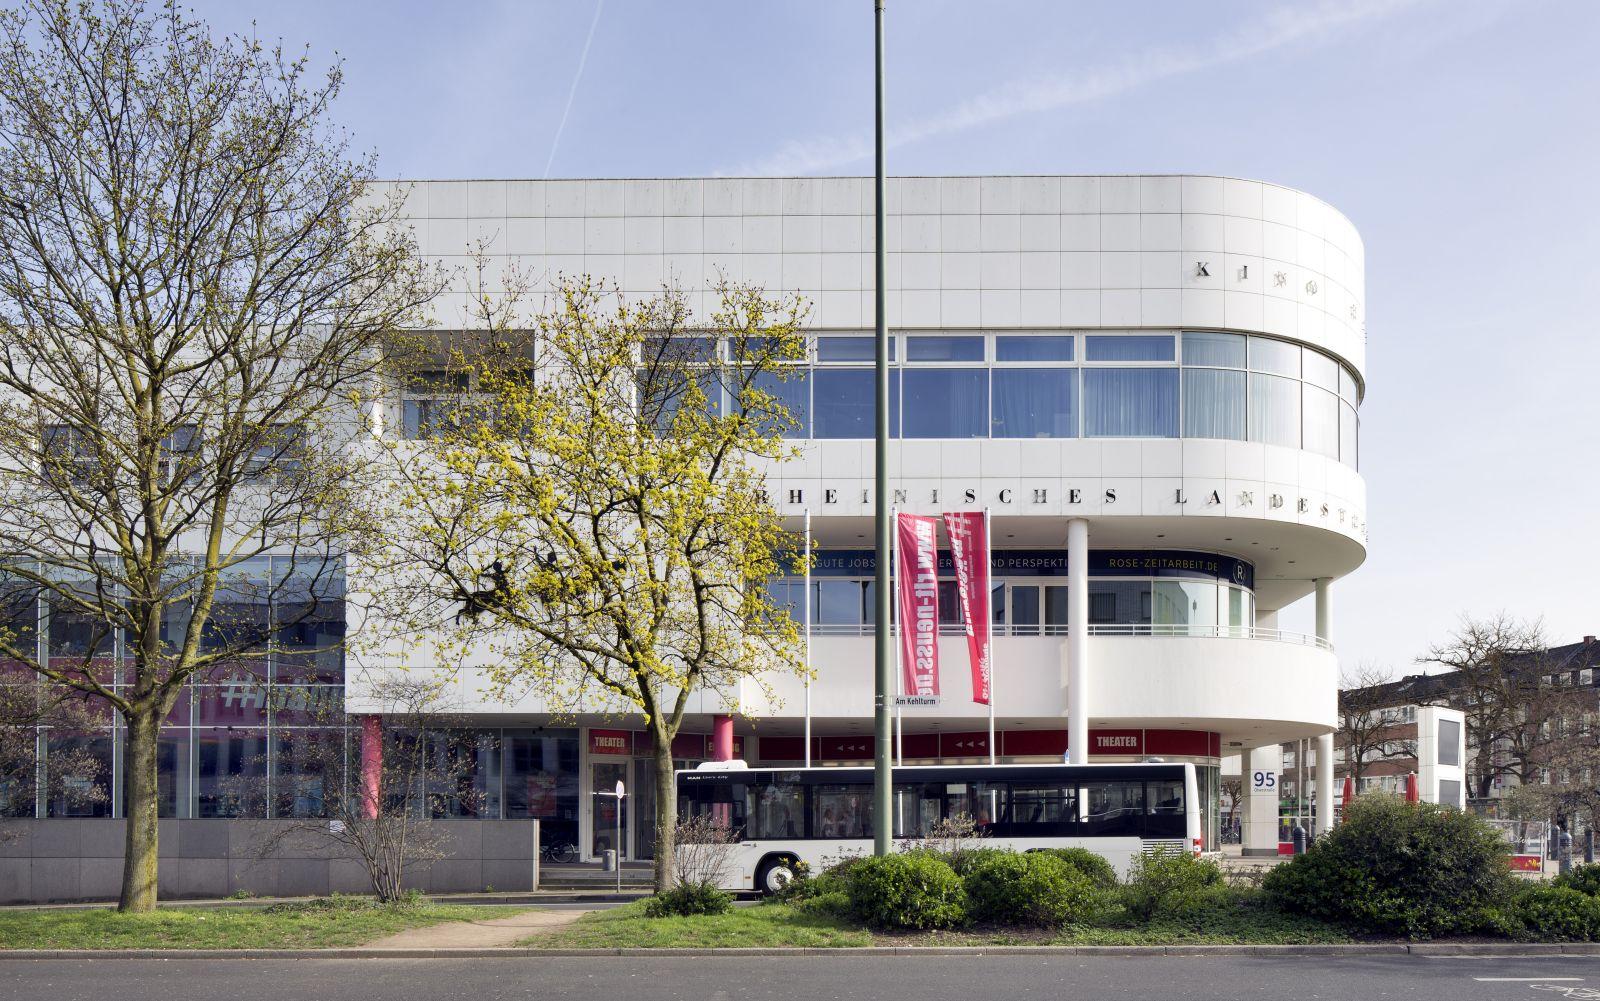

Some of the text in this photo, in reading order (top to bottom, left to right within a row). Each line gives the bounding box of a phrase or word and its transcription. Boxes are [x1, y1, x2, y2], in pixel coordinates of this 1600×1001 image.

[756, 489, 1116, 504] RHEINISCHES
[816, 559, 844, 568] GUTE
[848, 559, 875, 568] JOBS
[1008, 558, 1068, 568] PERSPEKTI
[1109, 558, 1218, 571] ROSE-ZEITARBEIT.DE
[896, 697, 906, 705] Am
[594, 736, 625, 748] THEATER
[1096, 736, 1137, 747] THEATER
[1254, 771, 1275, 787] 95
